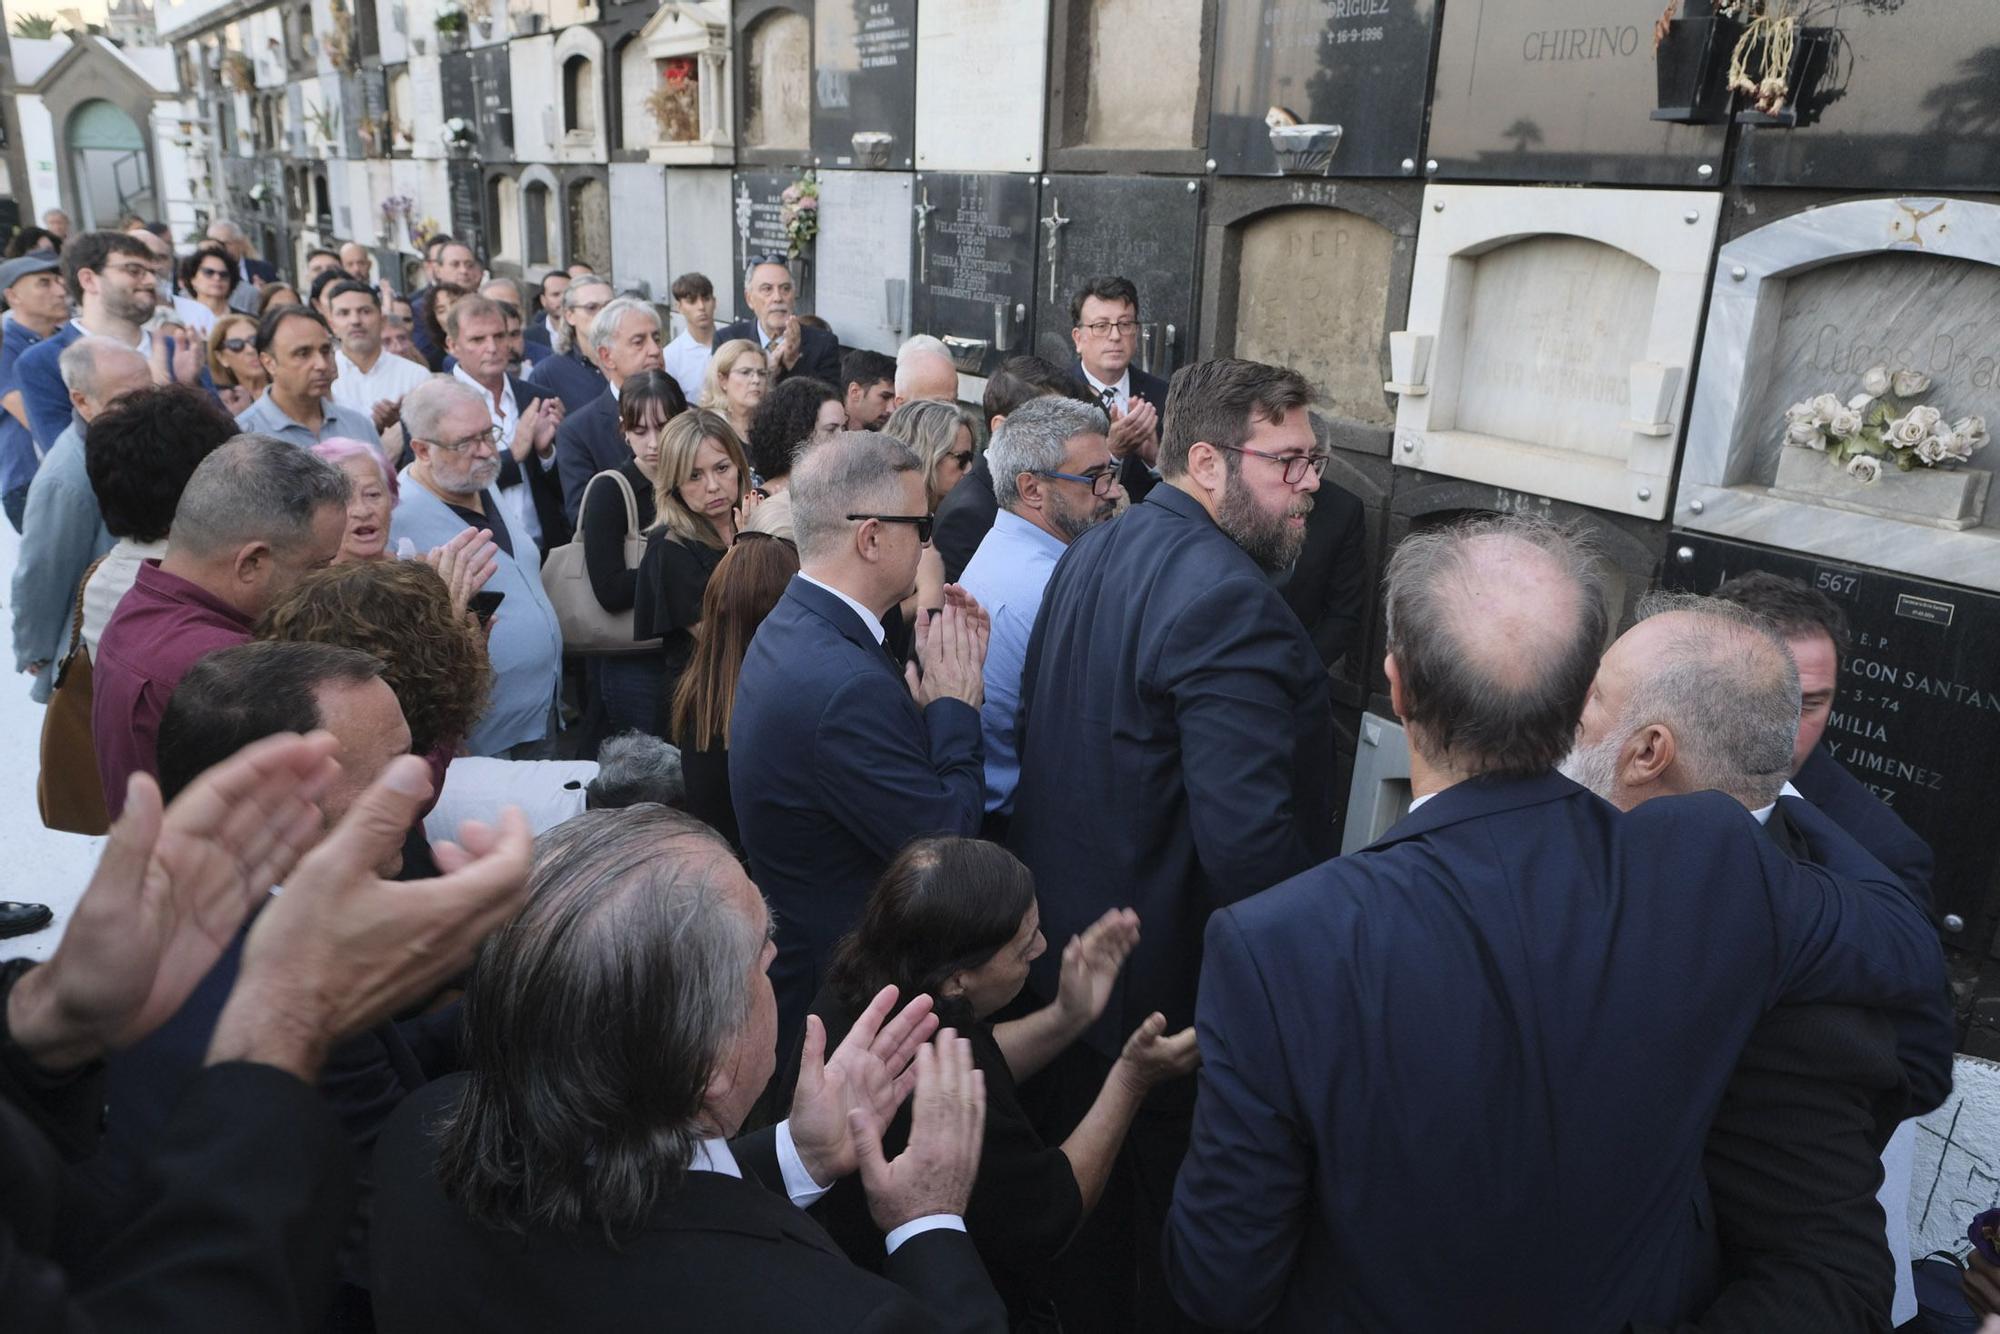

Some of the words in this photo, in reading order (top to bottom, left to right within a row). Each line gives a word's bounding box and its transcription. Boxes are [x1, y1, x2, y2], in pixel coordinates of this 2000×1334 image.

[1522, 25, 1639, 61] CHIRINO
[1816, 571, 1857, 594] 567
[1841, 654, 1899, 684] LCON
[1828, 711, 1888, 742] MILIA
[1828, 740, 1842, 757] Y
[1847, 748, 1944, 791] JIMENEZ
